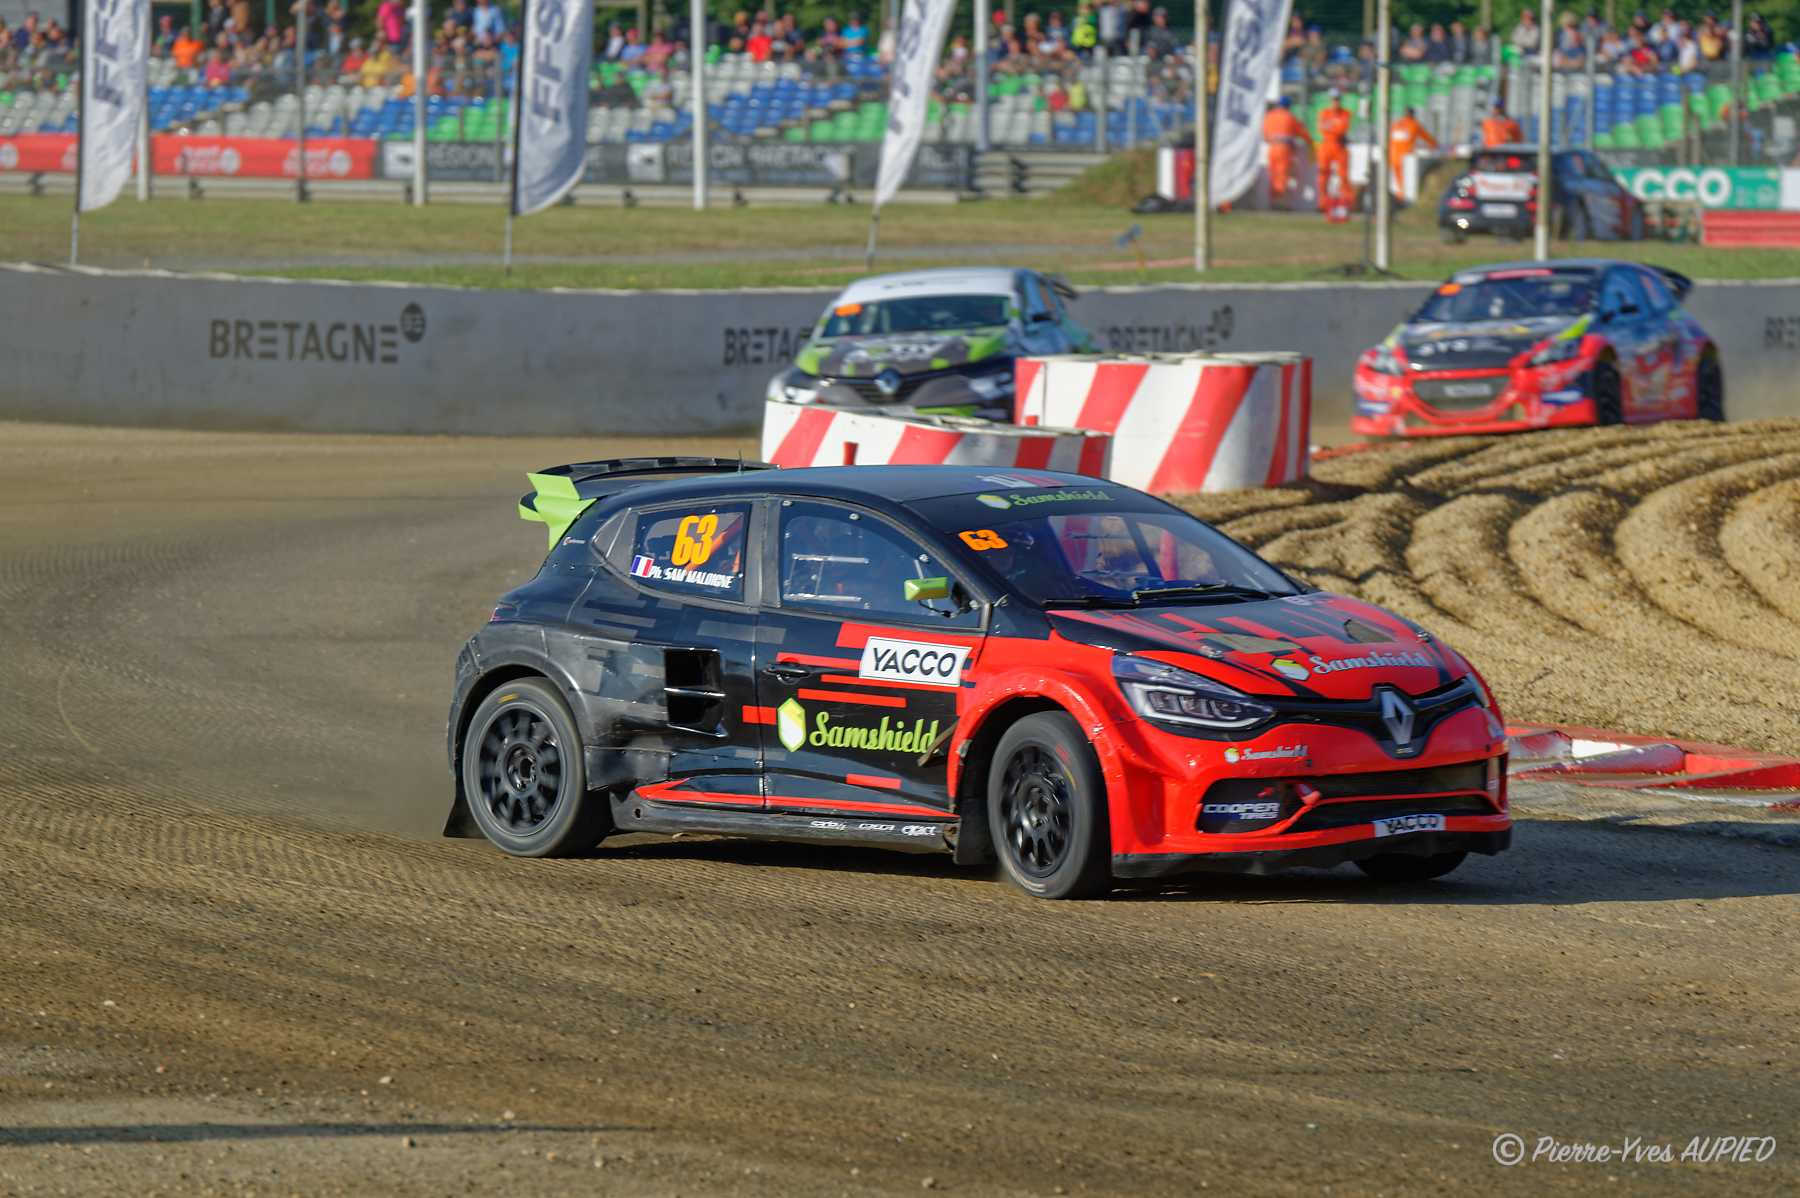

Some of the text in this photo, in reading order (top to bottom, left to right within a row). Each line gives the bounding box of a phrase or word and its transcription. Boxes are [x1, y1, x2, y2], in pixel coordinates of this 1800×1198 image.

[209, 319, 398, 364] BRETAGNE
[671, 513, 719, 567] 63
[959, 529, 1009, 551] 63
[663, 567, 687, 583] SAM
[873, 647, 957, 678] YACCO
[1309, 651, 1434, 674] Samshield
[809, 711, 940, 754] Samshield
[1203, 802, 1280, 813] COOPER
[1386, 815, 1440, 833] YACCO
